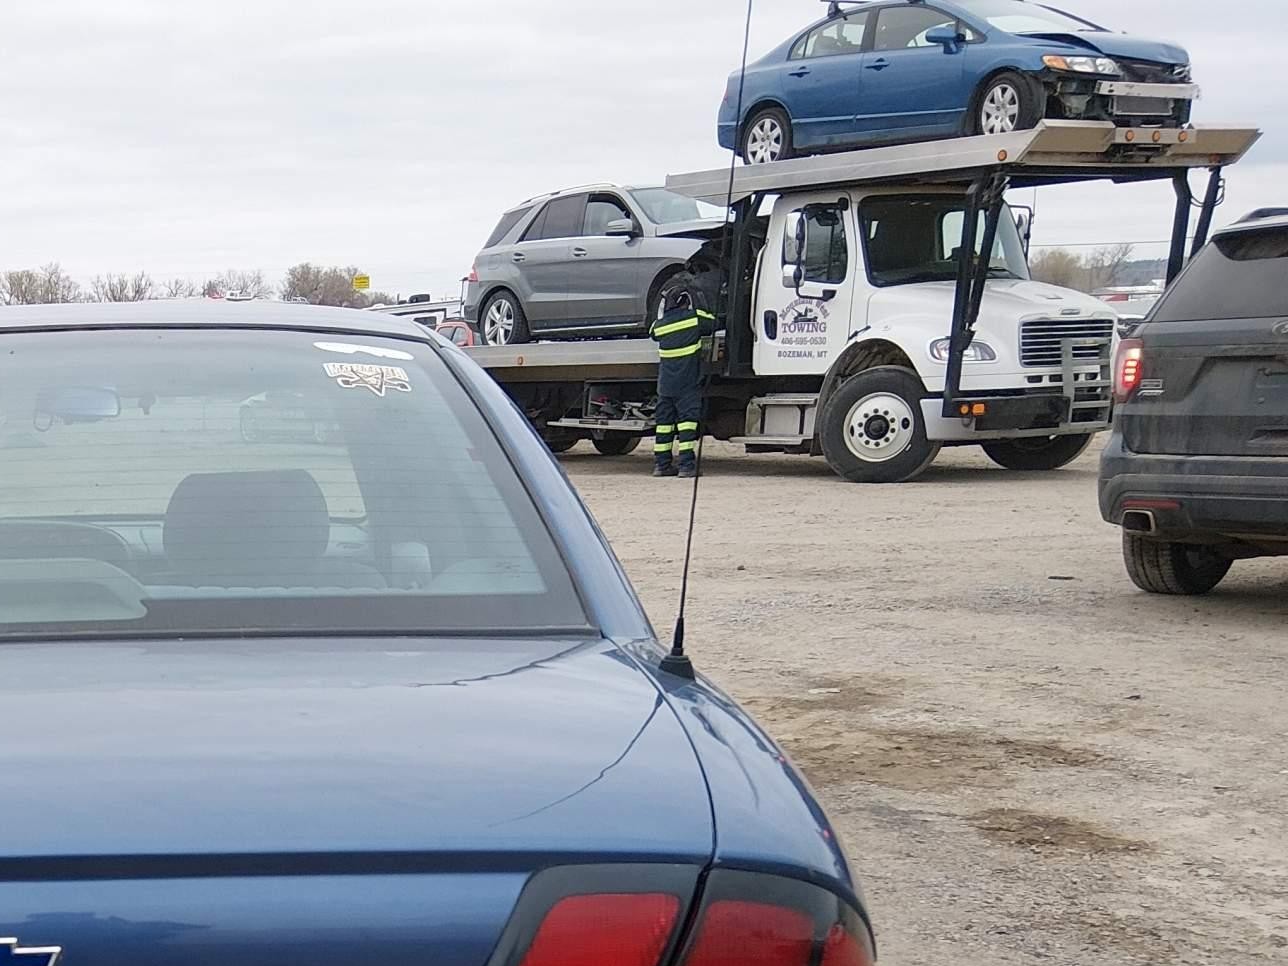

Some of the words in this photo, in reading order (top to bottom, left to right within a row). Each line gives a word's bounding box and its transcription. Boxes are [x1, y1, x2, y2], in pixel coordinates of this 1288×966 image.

[781, 321, 827, 333] TOWING
[777, 350, 815, 358] BOZEMAN,
[817, 350, 828, 358] MT
